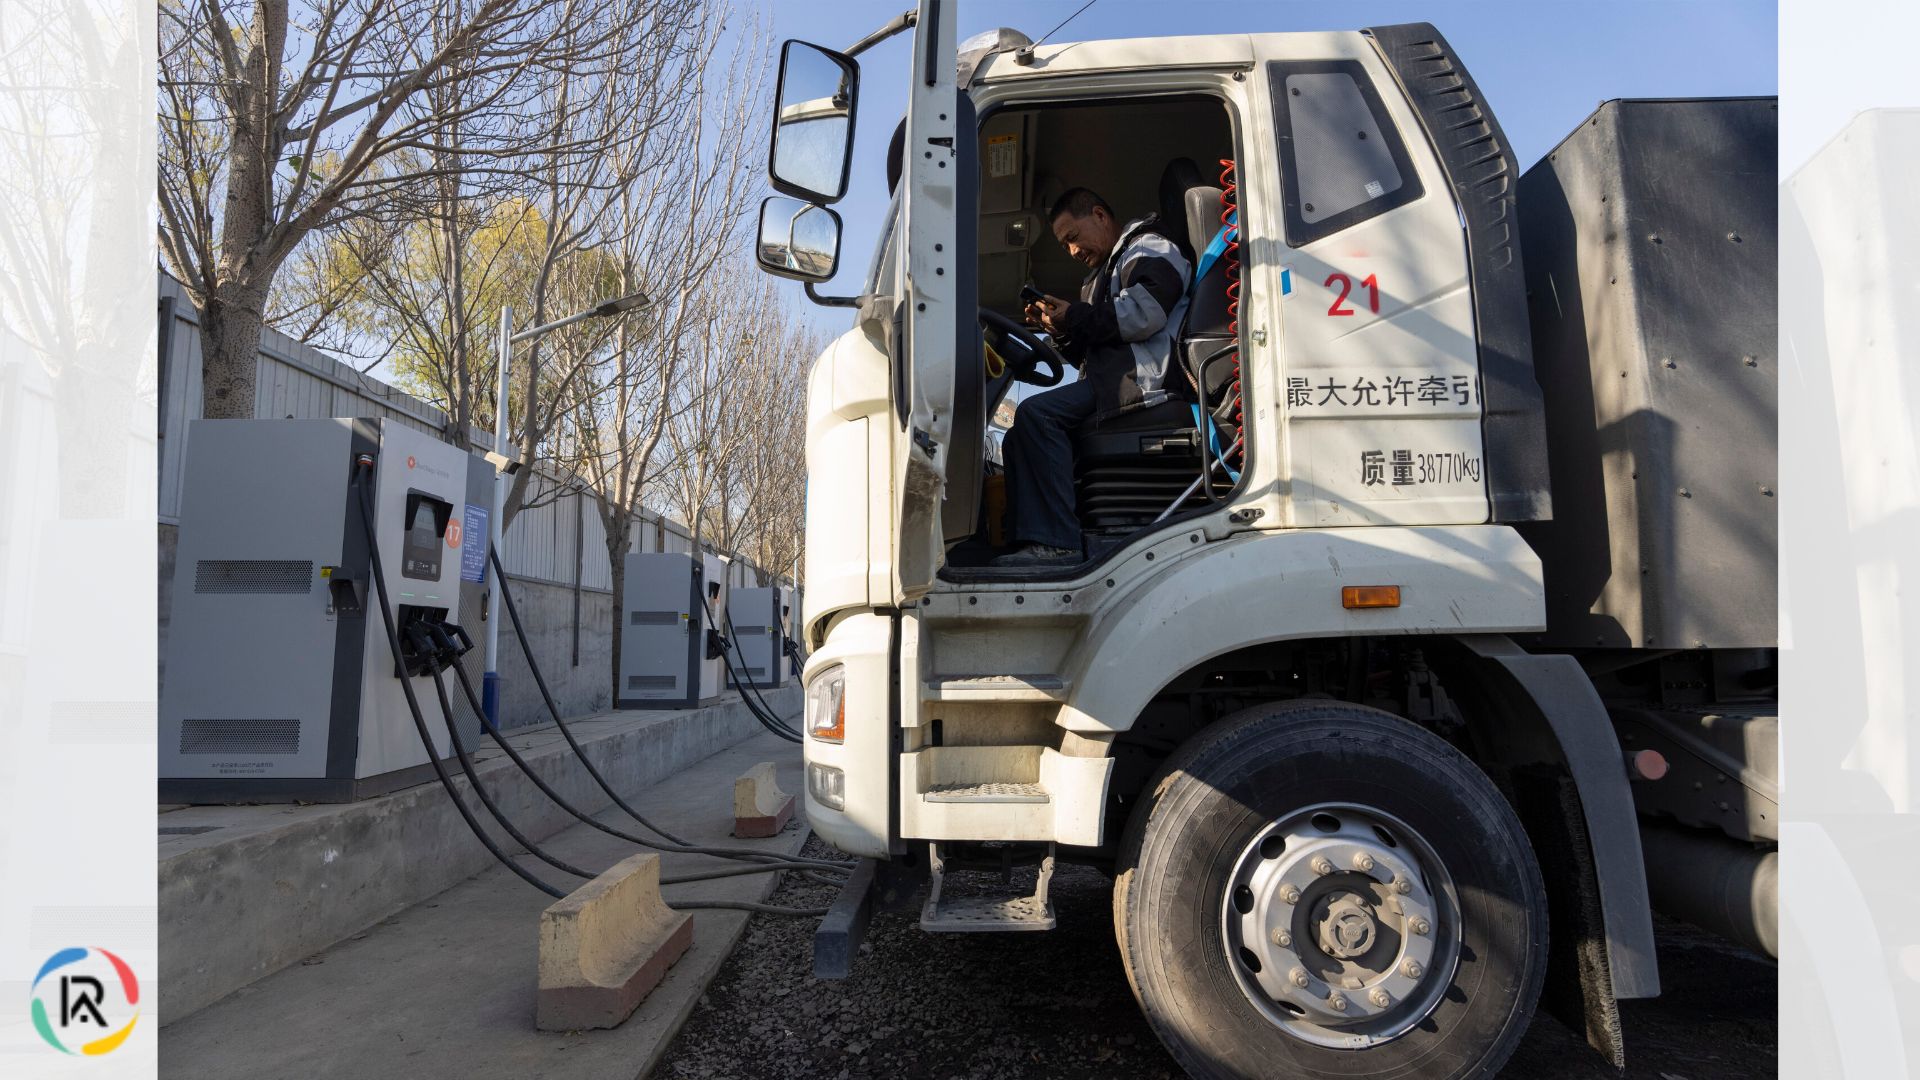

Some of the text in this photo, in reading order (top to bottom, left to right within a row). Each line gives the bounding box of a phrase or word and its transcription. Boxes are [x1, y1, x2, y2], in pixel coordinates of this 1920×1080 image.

[1324, 272, 1380, 317] 21
[1286, 374, 1481, 410] 最大允许牵引
[1361, 449, 1481, 487] 质量38770kg
[447, 525, 461, 542] 17
